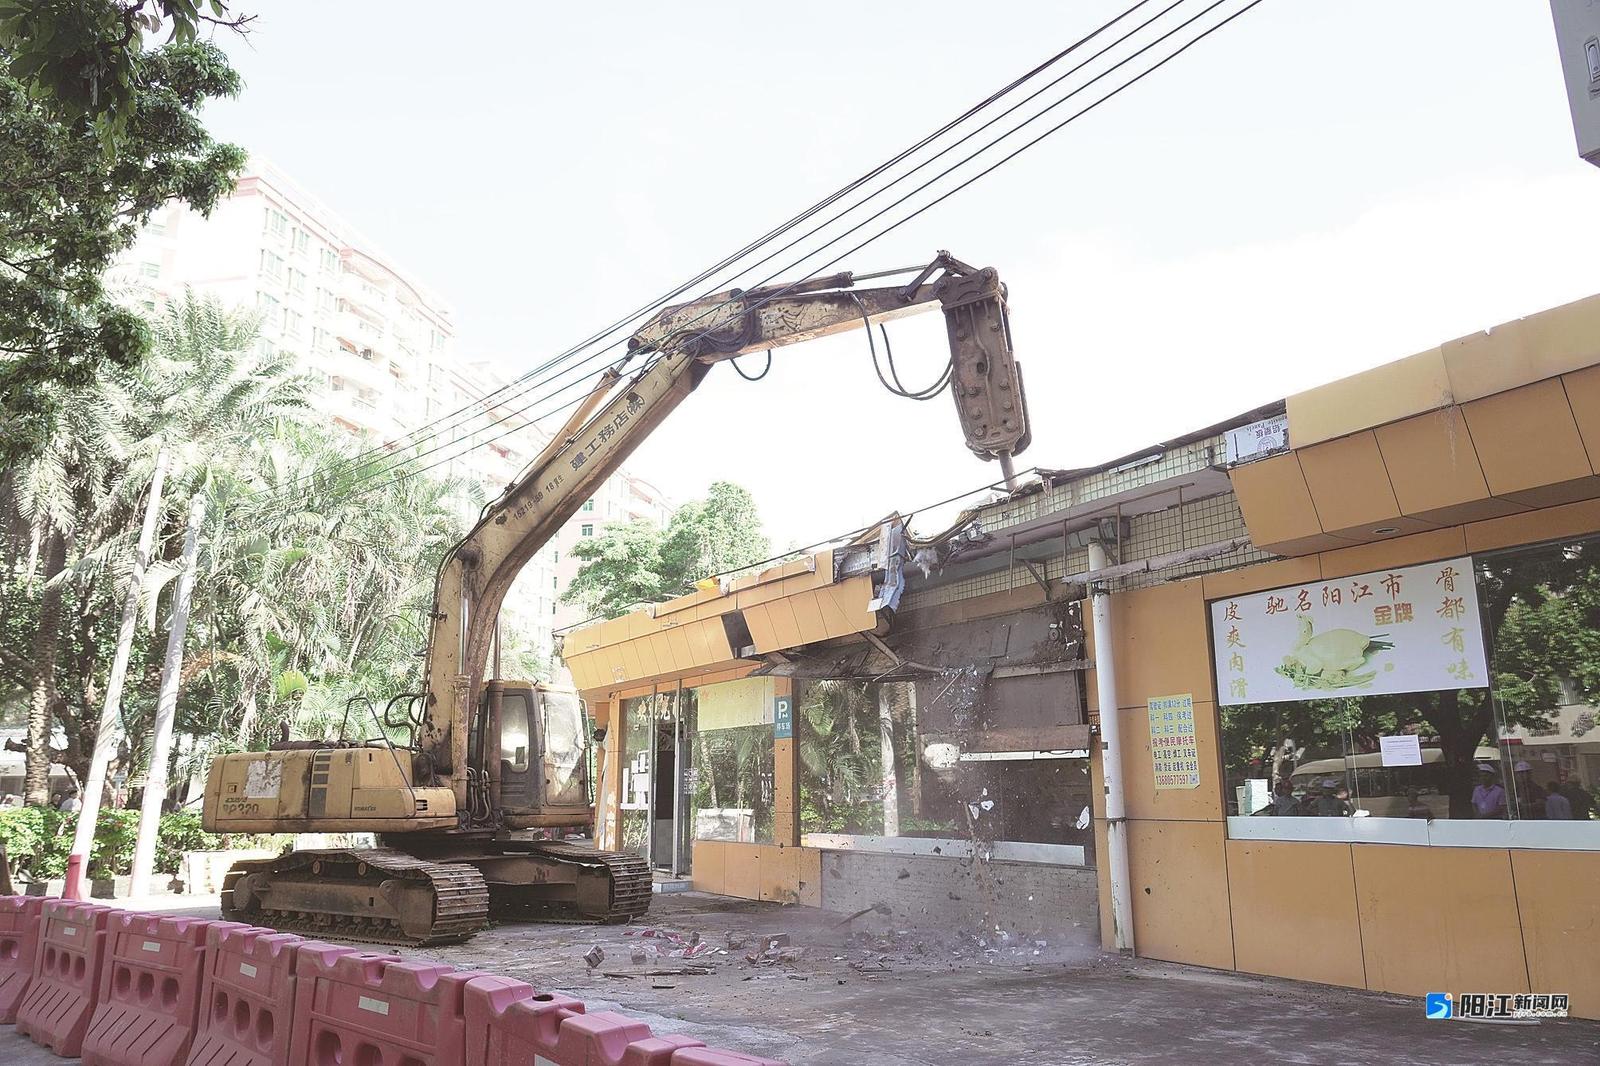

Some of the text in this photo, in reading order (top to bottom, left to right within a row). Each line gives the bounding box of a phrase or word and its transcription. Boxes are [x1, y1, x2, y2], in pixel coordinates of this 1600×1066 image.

[1265, 574, 1403, 616] 驰名阳江市
[1373, 602, 1414, 626] 金牌
[1435, 566, 1474, 682] 骨都有味
[1223, 601, 1249, 699] 皮爽肉滑
